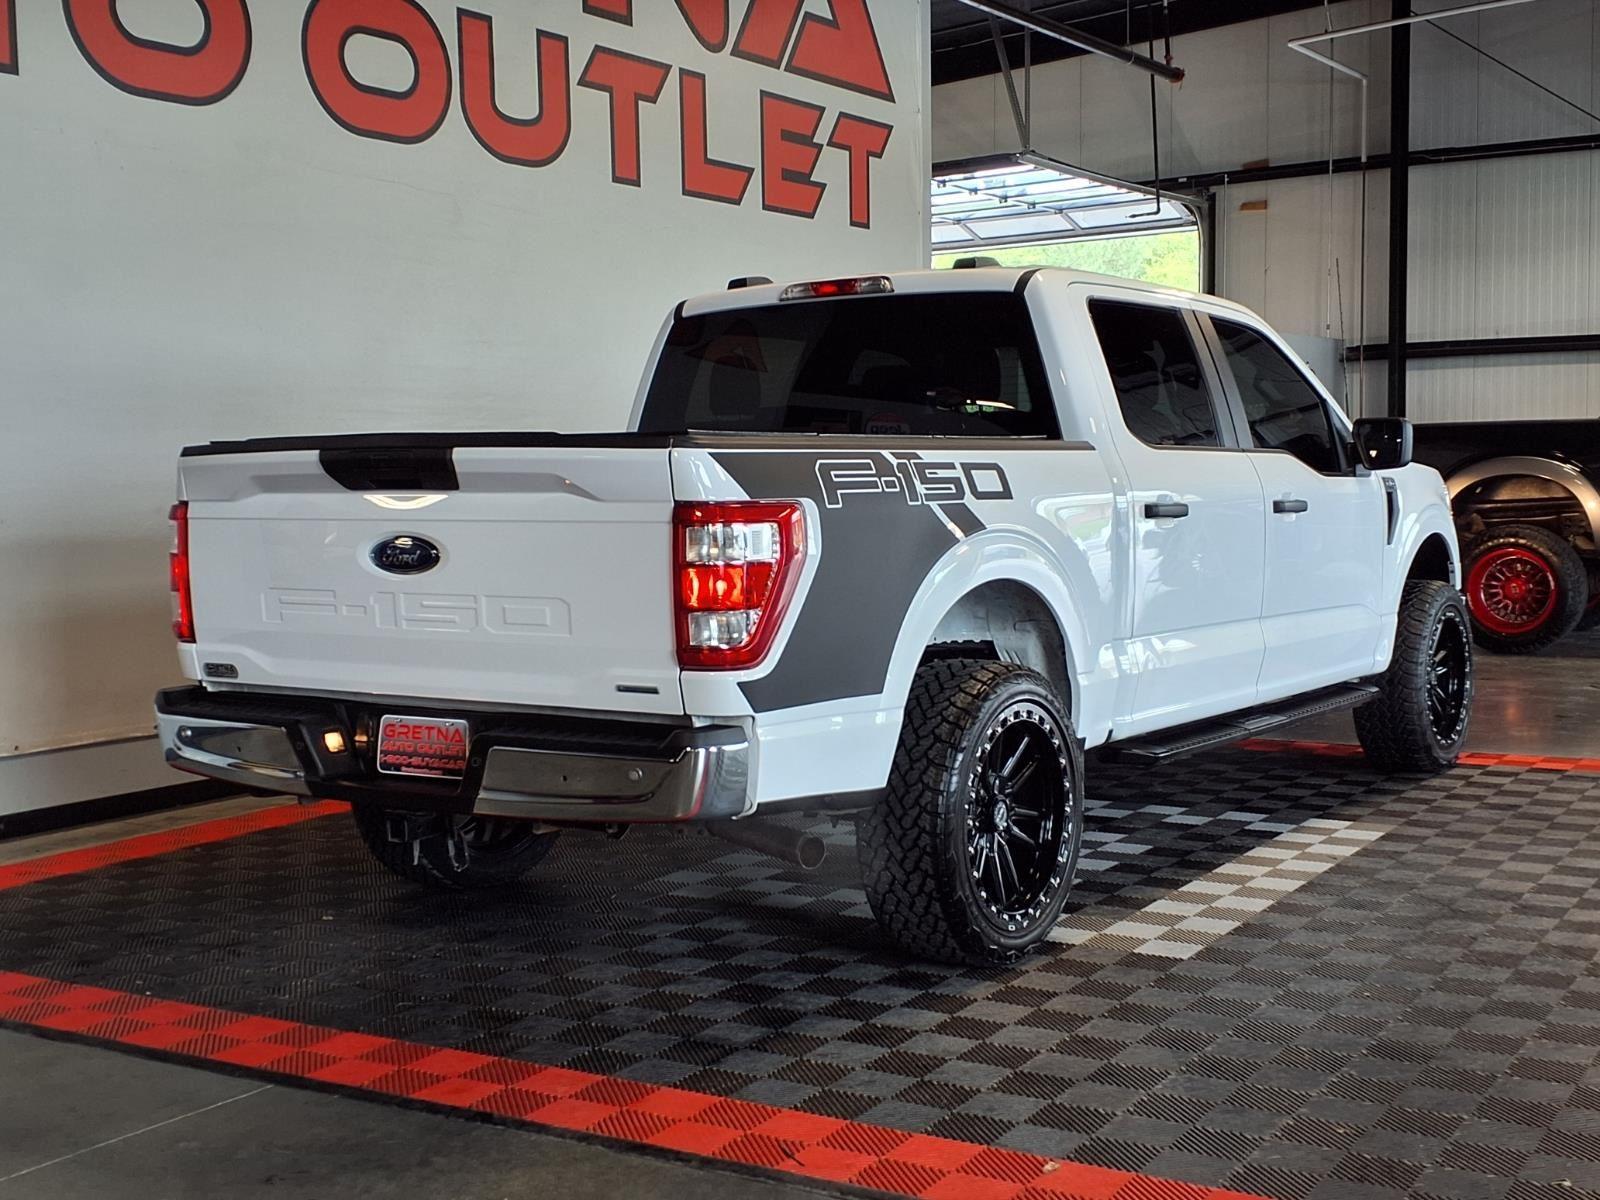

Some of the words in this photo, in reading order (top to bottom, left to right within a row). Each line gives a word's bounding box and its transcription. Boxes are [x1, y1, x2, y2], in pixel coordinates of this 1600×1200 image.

[301, 0, 894, 229] OUTLET
[815, 459, 1013, 508] F-150
[261, 587, 571, 637] F-150
[383, 723, 465, 743] GRETNA
